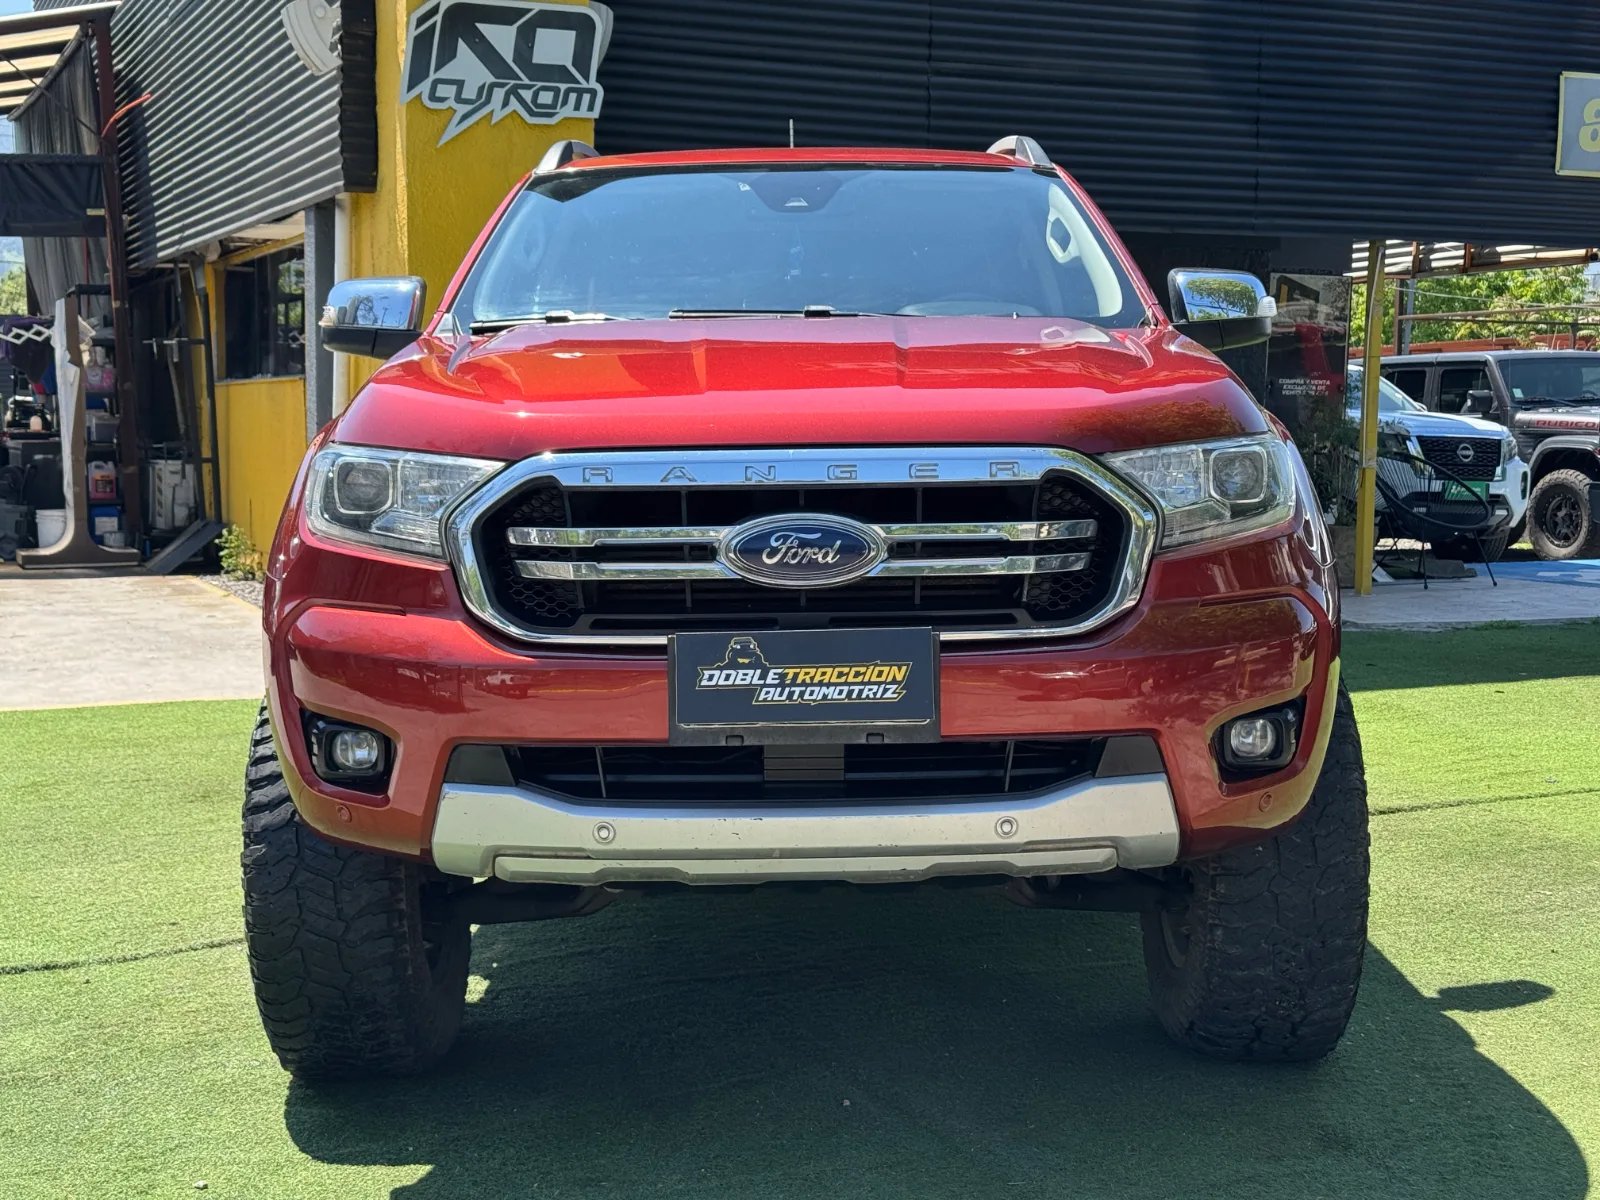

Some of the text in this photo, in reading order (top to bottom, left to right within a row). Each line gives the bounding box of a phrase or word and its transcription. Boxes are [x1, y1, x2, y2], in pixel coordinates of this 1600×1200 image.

[1535, 420, 1600, 428] RUBICO
[582, 461, 1021, 483] RANGER
[761, 531, 843, 565] Ford
